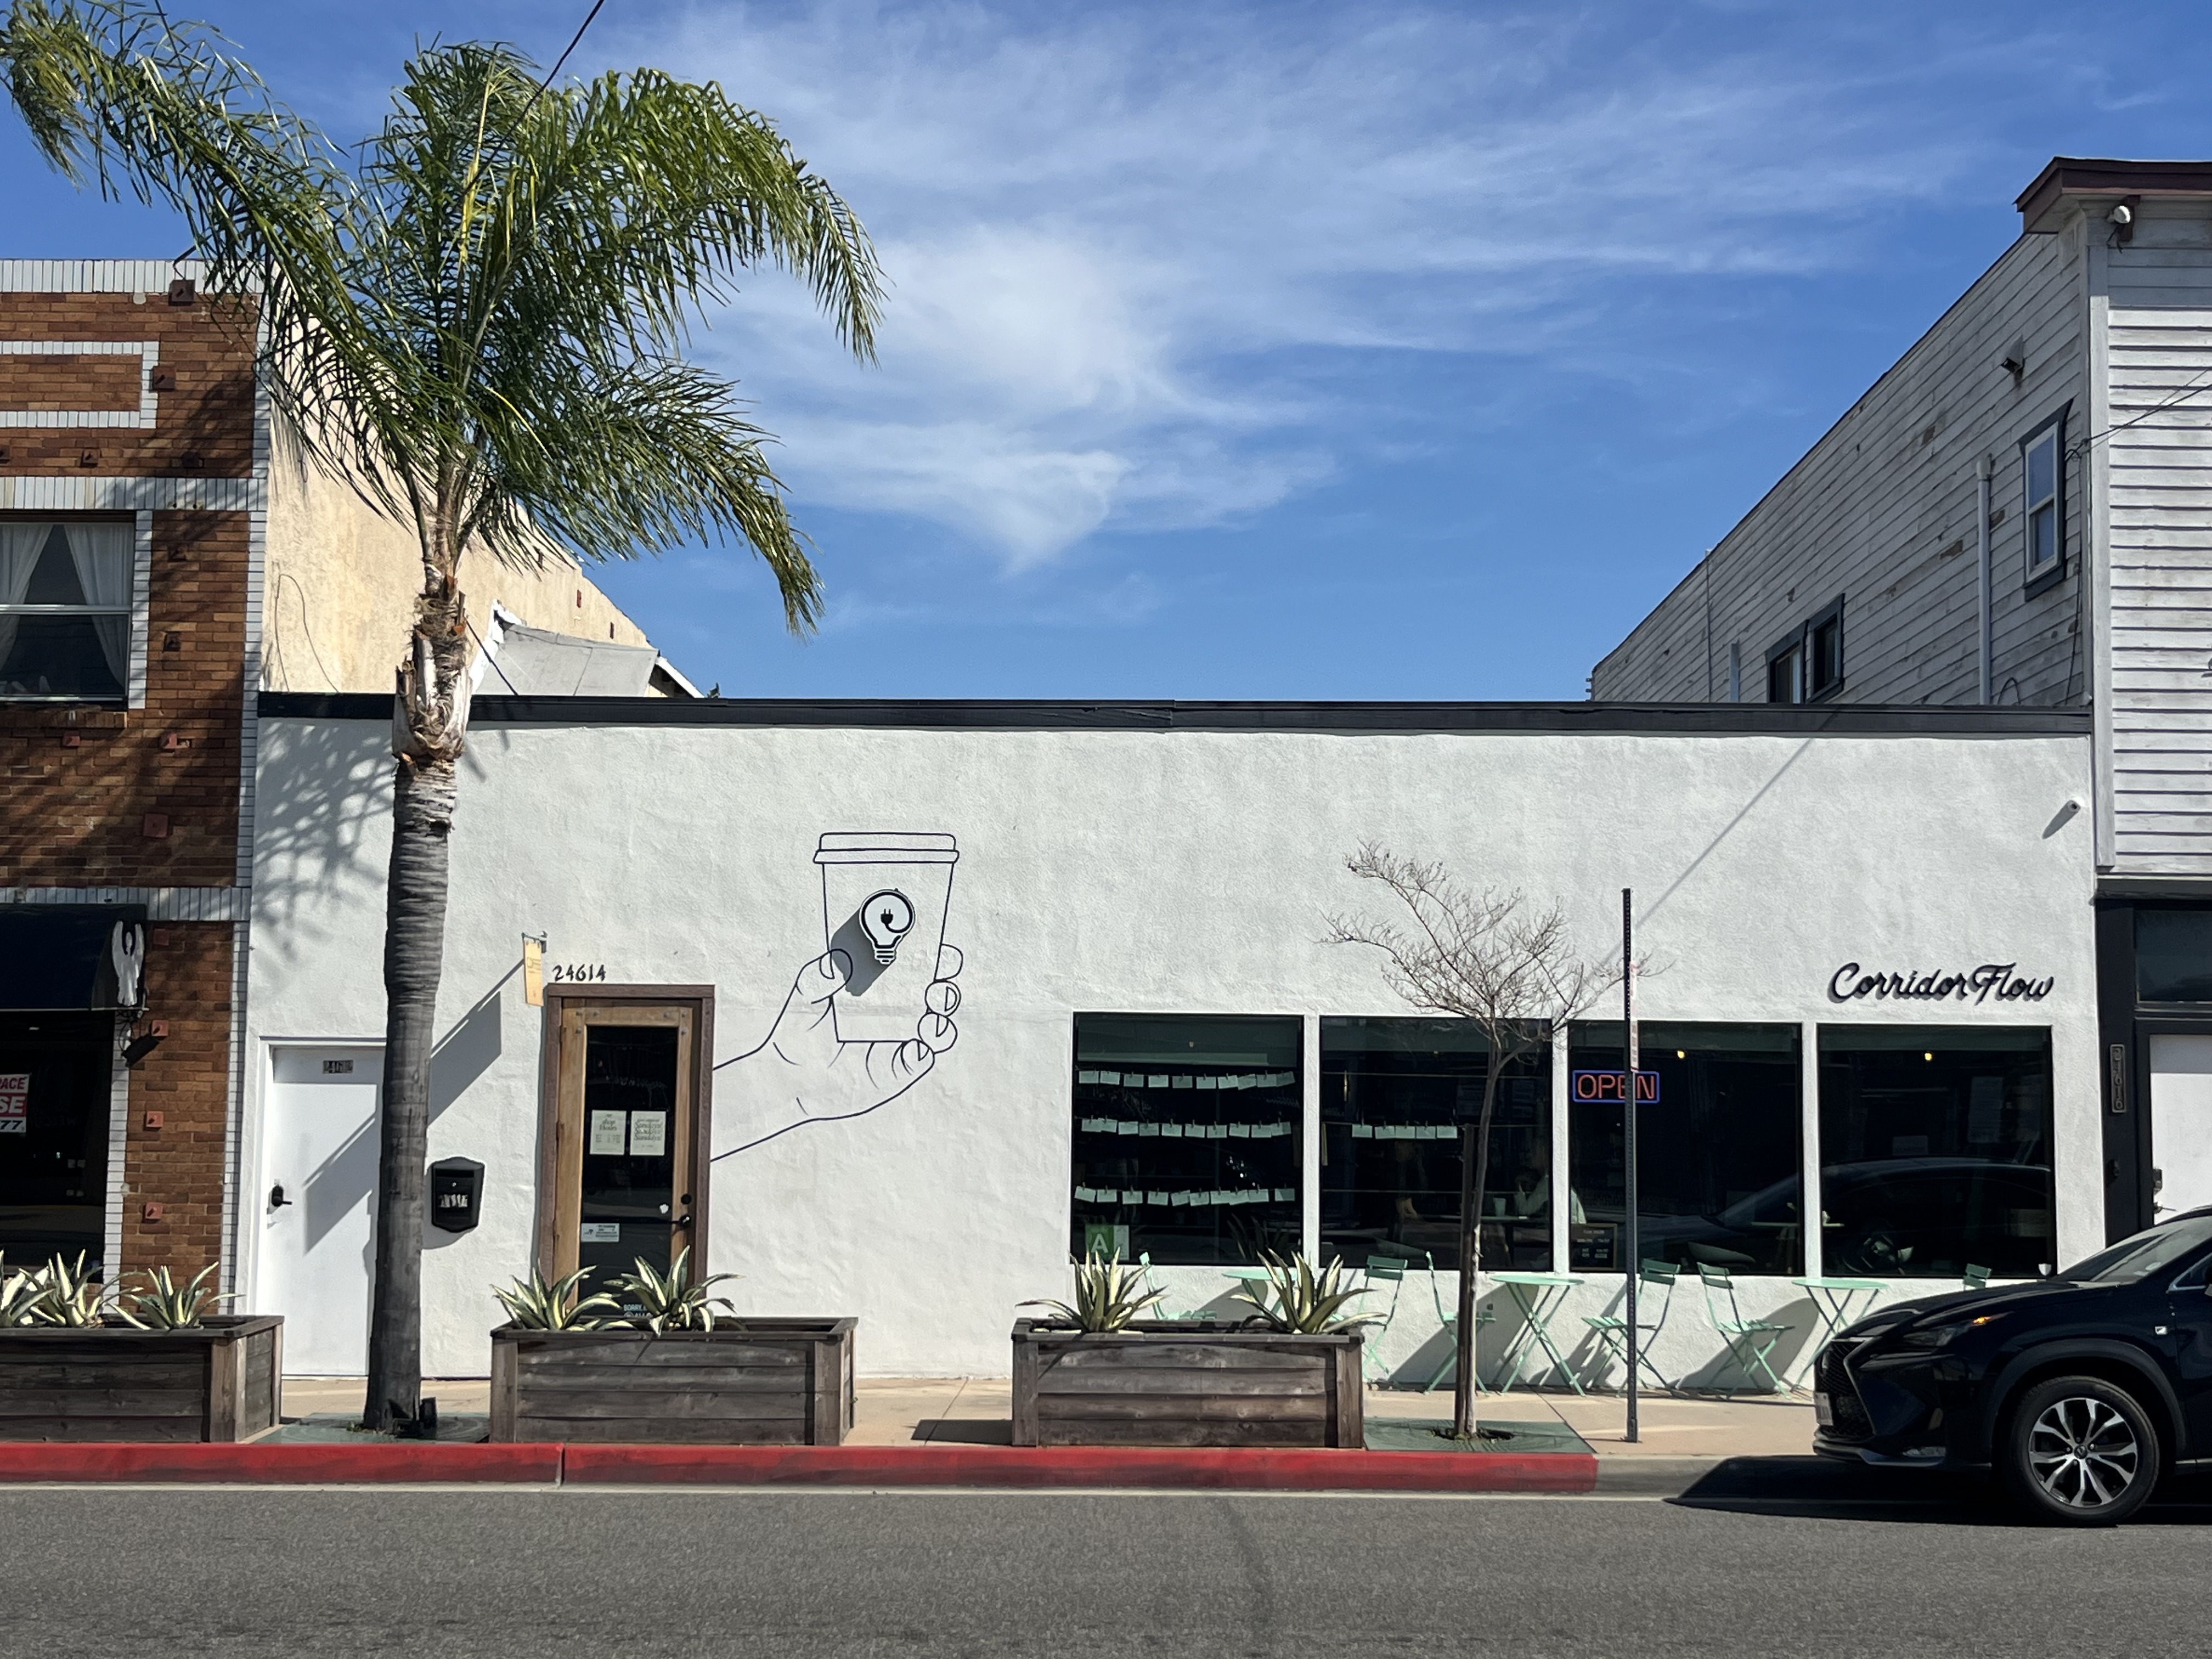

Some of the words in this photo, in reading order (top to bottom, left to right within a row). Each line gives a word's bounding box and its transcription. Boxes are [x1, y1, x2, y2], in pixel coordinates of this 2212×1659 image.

[551, 963, 606, 981] 24614
[0, 1077, 27, 1090] ACE
[1091, 1233, 1109, 1253] A
